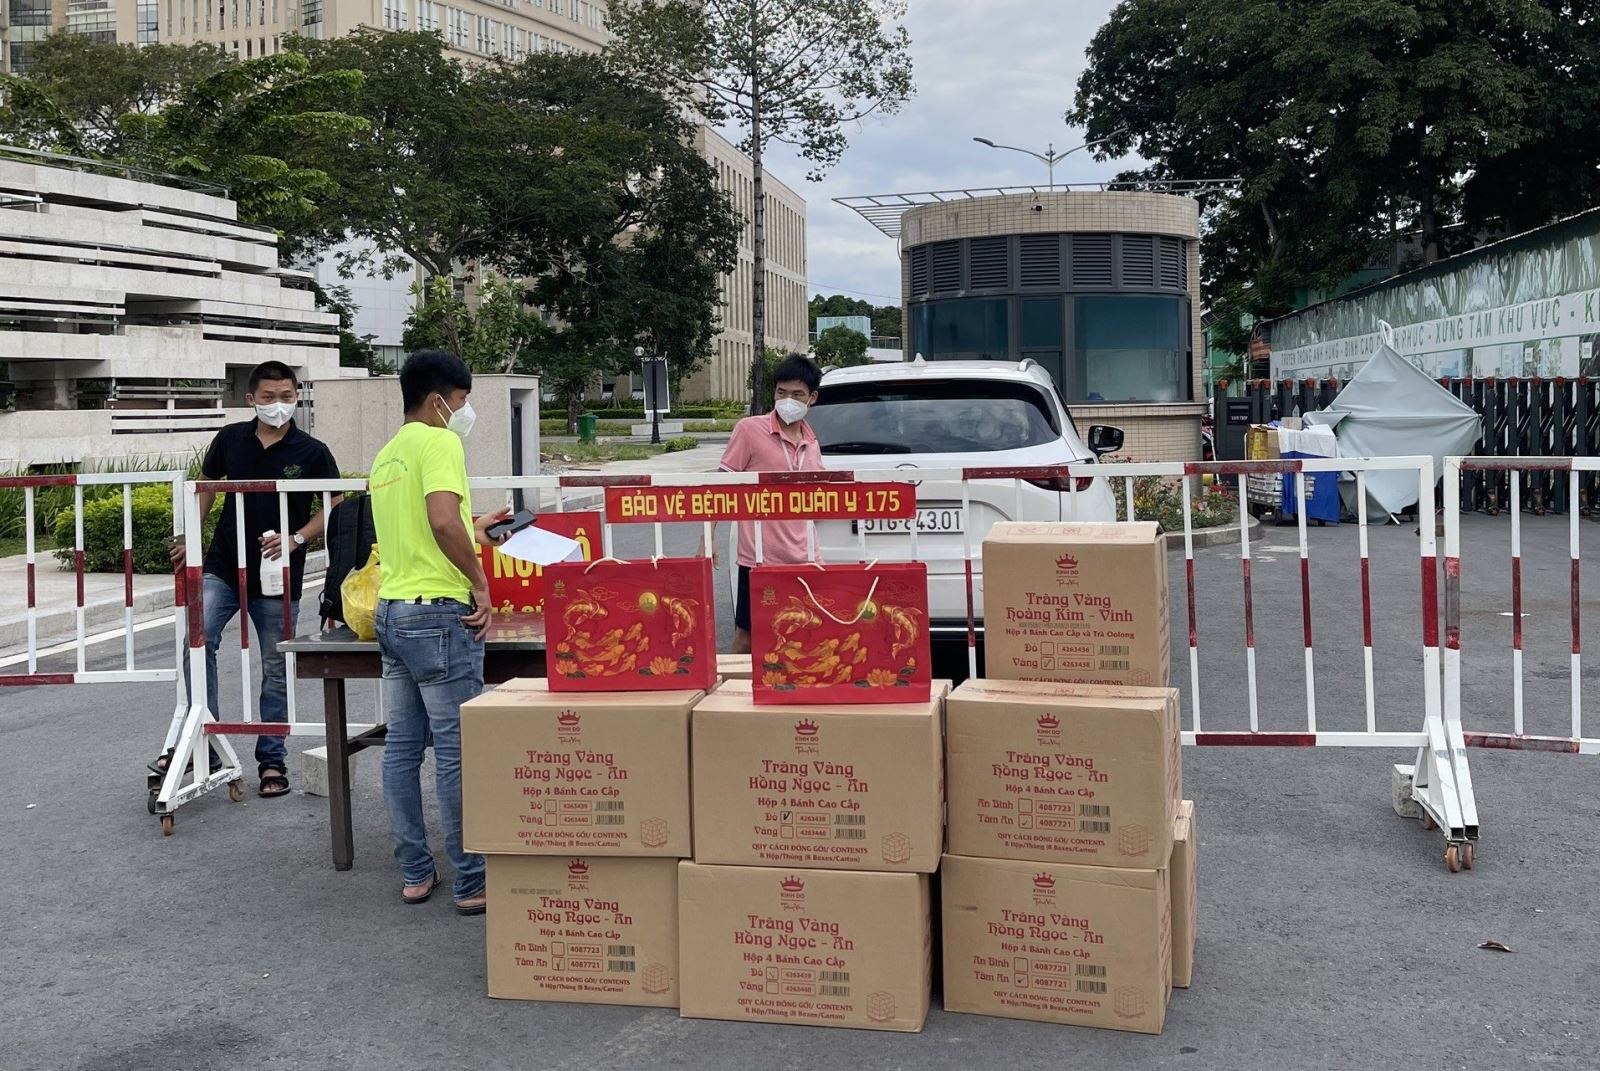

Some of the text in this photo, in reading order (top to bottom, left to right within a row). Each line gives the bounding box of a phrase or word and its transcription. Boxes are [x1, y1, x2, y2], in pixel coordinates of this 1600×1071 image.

[1499, 307, 1523, 335] KHU
[1531, 298, 1561, 336] VỰC
[621, 487, 900, 518] BẢO VỆ BỆNH VIỆN QUÂN Y 175
[1025, 592, 1111, 608] Trăng Vàng
[1006, 607, 1051, 622] Hoàng
[1055, 608, 1084, 621] Kim
[1099, 609, 1133, 622] Vinh
[1006, 628, 1020, 636] Hộp
[1066, 629, 1081, 638] Cấp
[1107, 630, 1135, 639] Oolong
[1024, 643, 1038, 652] Đỏ
[1012, 657, 1038, 667] Vàng
[526, 750, 614, 766] Trăng Vàng
[1005, 751, 1094, 769] Trăng Vàng
[514, 765, 551, 782] Hồng
[555, 767, 592, 782] Ngọc
[761, 760, 854, 778] Trăng Vàng
[992, 763, 1029, 780] Hồng
[1034, 767, 1072, 782] Ngọc
[523, 786, 620, 797] Hộp 4 Bánh Cao Cấp
[749, 775, 787, 793] Hồng
[792, 778, 831, 793] Ngọc
[1005, 784, 1023, 794] Hộp
[1034, 786, 1055, 795] Bánh
[1058, 788, 1075, 796] Cao
[1077, 788, 1095, 798] Cấp
[758, 797, 777, 808] Hộp
[790, 799, 815, 808] Bánh
[818, 800, 837, 808] Cao
[840, 799, 860, 811] Cấp
[1038, 804, 1071, 812] 4087723
[520, 815, 542, 825] Vàng
[1039, 820, 1071, 828] 4087721
[754, 826, 778, 837] Vàng
[539, 897, 619, 913] Trăng Vàng
[527, 909, 561, 924] Hồng
[566, 911, 600, 925] Ngọc
[748, 915, 839, 935] Trăng Vàng
[1001, 909, 1089, 930] Trăng Vàng
[540, 928, 555, 938] Hộp
[558, 929, 563, 937] 4
[566, 929, 585, 938] Bánh
[604, 930, 621, 940] Cấp
[734, 930, 772, 948] Hồng
[777, 933, 817, 950] Ngọc
[987, 922, 1025, 940] Hồng
[1029, 926, 1068, 942] Ngọc
[1001, 943, 1090, 959] Hộp 4 Bánh Cao Cấp
[743, 952, 845, 969] Hộp 4 Bánh Cao Cấp
[1034, 964, 1067, 972] 4087723
[739, 982, 763, 992] Vàng
[1034, 979, 1067, 988] 4087721
